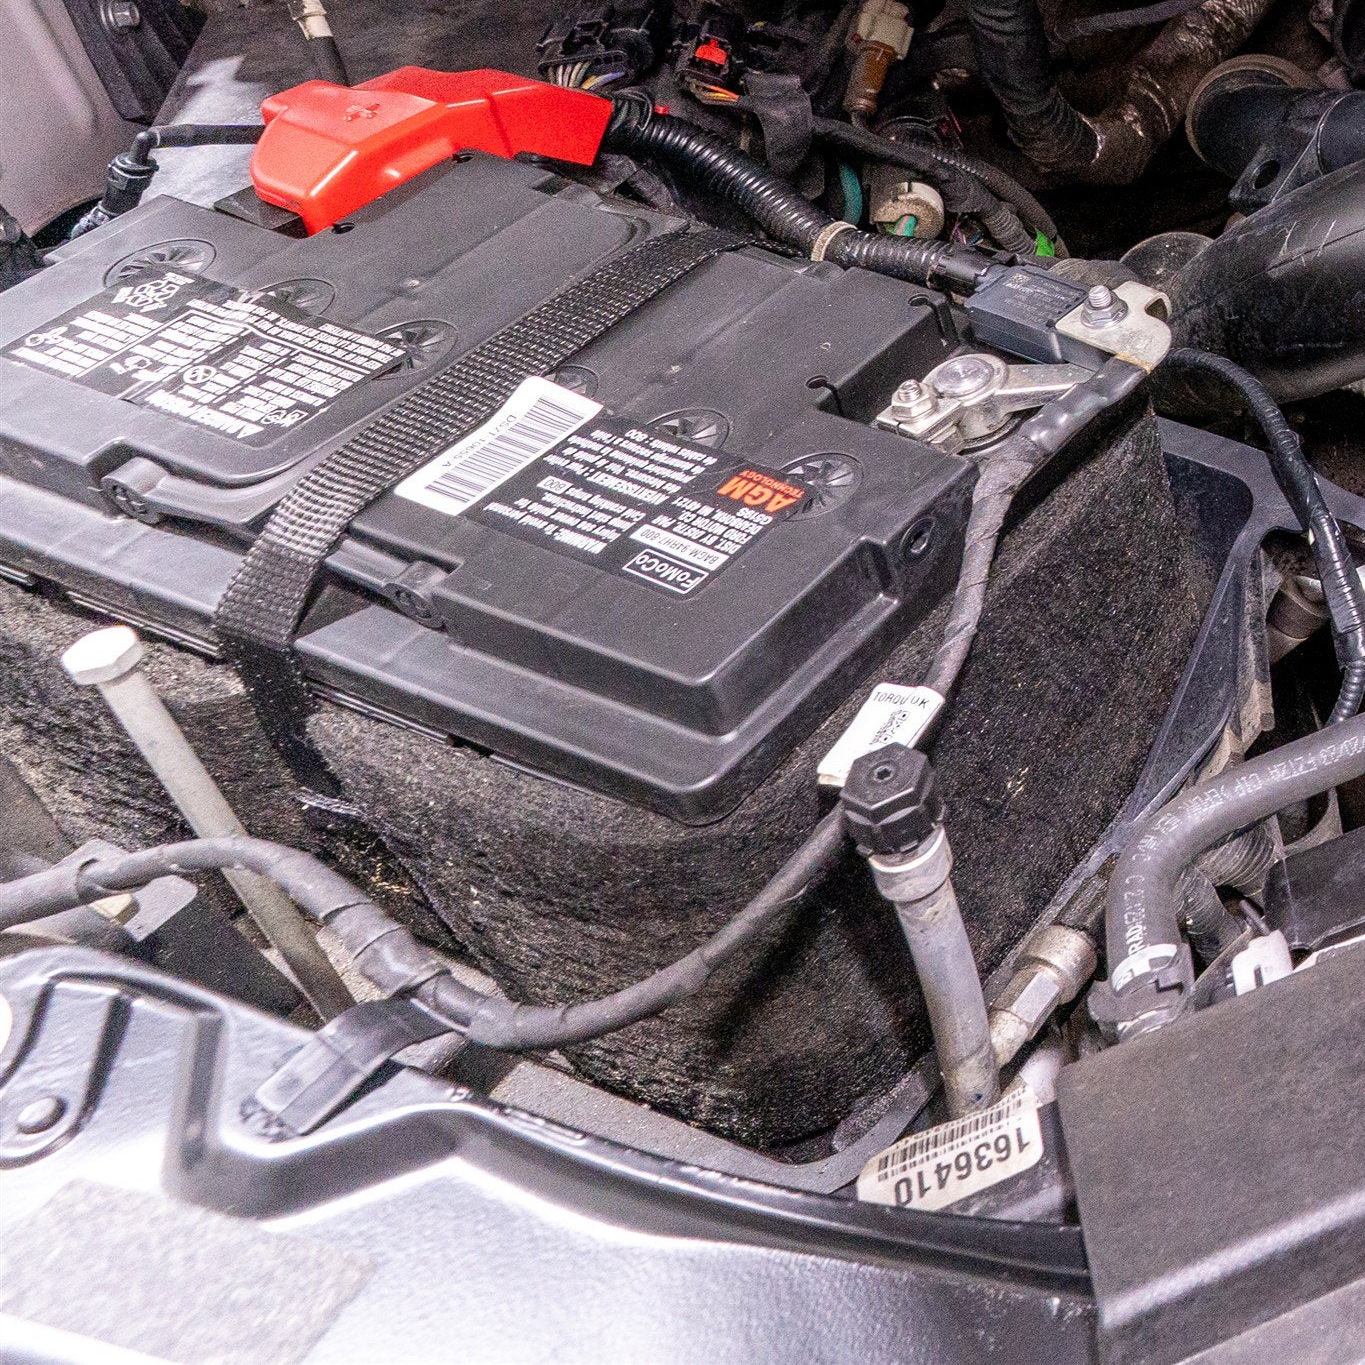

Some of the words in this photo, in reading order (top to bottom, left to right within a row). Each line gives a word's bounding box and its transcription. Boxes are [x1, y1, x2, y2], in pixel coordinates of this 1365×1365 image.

[622, 428, 650, 442] 800
[541, 477, 568, 491] 800
[584, 469, 670, 506] AVERTISSEMENT
[736, 468, 807, 499] TECHNOLOGY
[510, 496, 533, 509] for
[714, 476, 798, 516] AGM
[481, 499, 527, 522] personal
[548, 510, 582, 526] owner
[584, 509, 614, 524] start
[619, 507, 648, 522] Cold
[673, 509, 697, 523] CO.
[516, 513, 550, 531] avoid
[574, 519, 598, 532] see
[689, 516, 729, 535] MOTOR
[549, 526, 609, 554] WARNING:
[721, 527, 753, 544] FORD
[629, 553, 701, 588] FoMoCo
[894, 1127, 1031, 1208] 1636410
